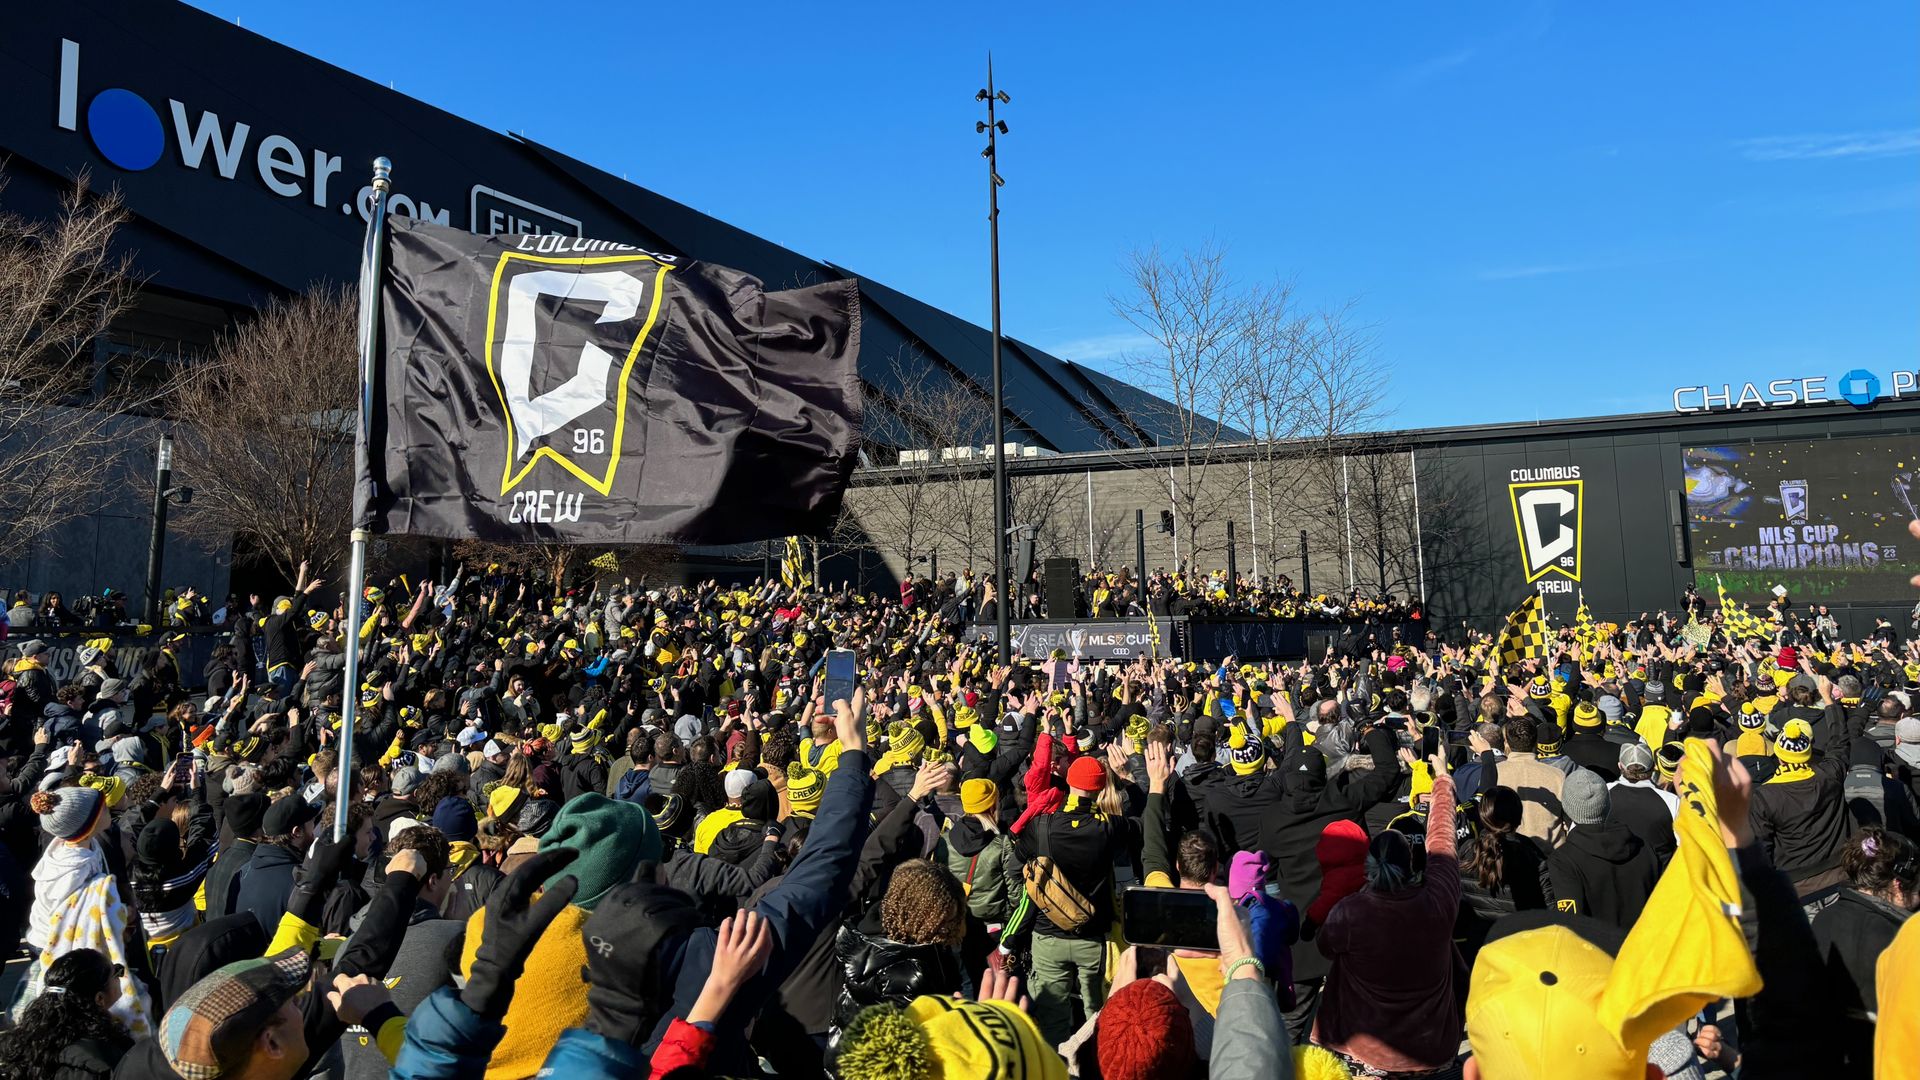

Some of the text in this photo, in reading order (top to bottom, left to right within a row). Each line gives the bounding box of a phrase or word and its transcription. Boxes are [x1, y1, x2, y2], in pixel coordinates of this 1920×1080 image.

[490, 208, 564, 238] FIE
[516, 235, 677, 262] COLUMS
[1673, 376, 1829, 413] CHASE
[572, 428, 605, 454] 96
[1510, 465, 1580, 481] COLUMBUS
[508, 489, 584, 524] CREW
[1758, 524, 1839, 545] MLS CUP
[1560, 556, 1575, 567] 96
[1723, 541, 1880, 569] CHAMPIONS
[1883, 548, 1896, 558] 23
[1536, 580, 1573, 594] CREW
[1089, 635, 1116, 646] MLS
